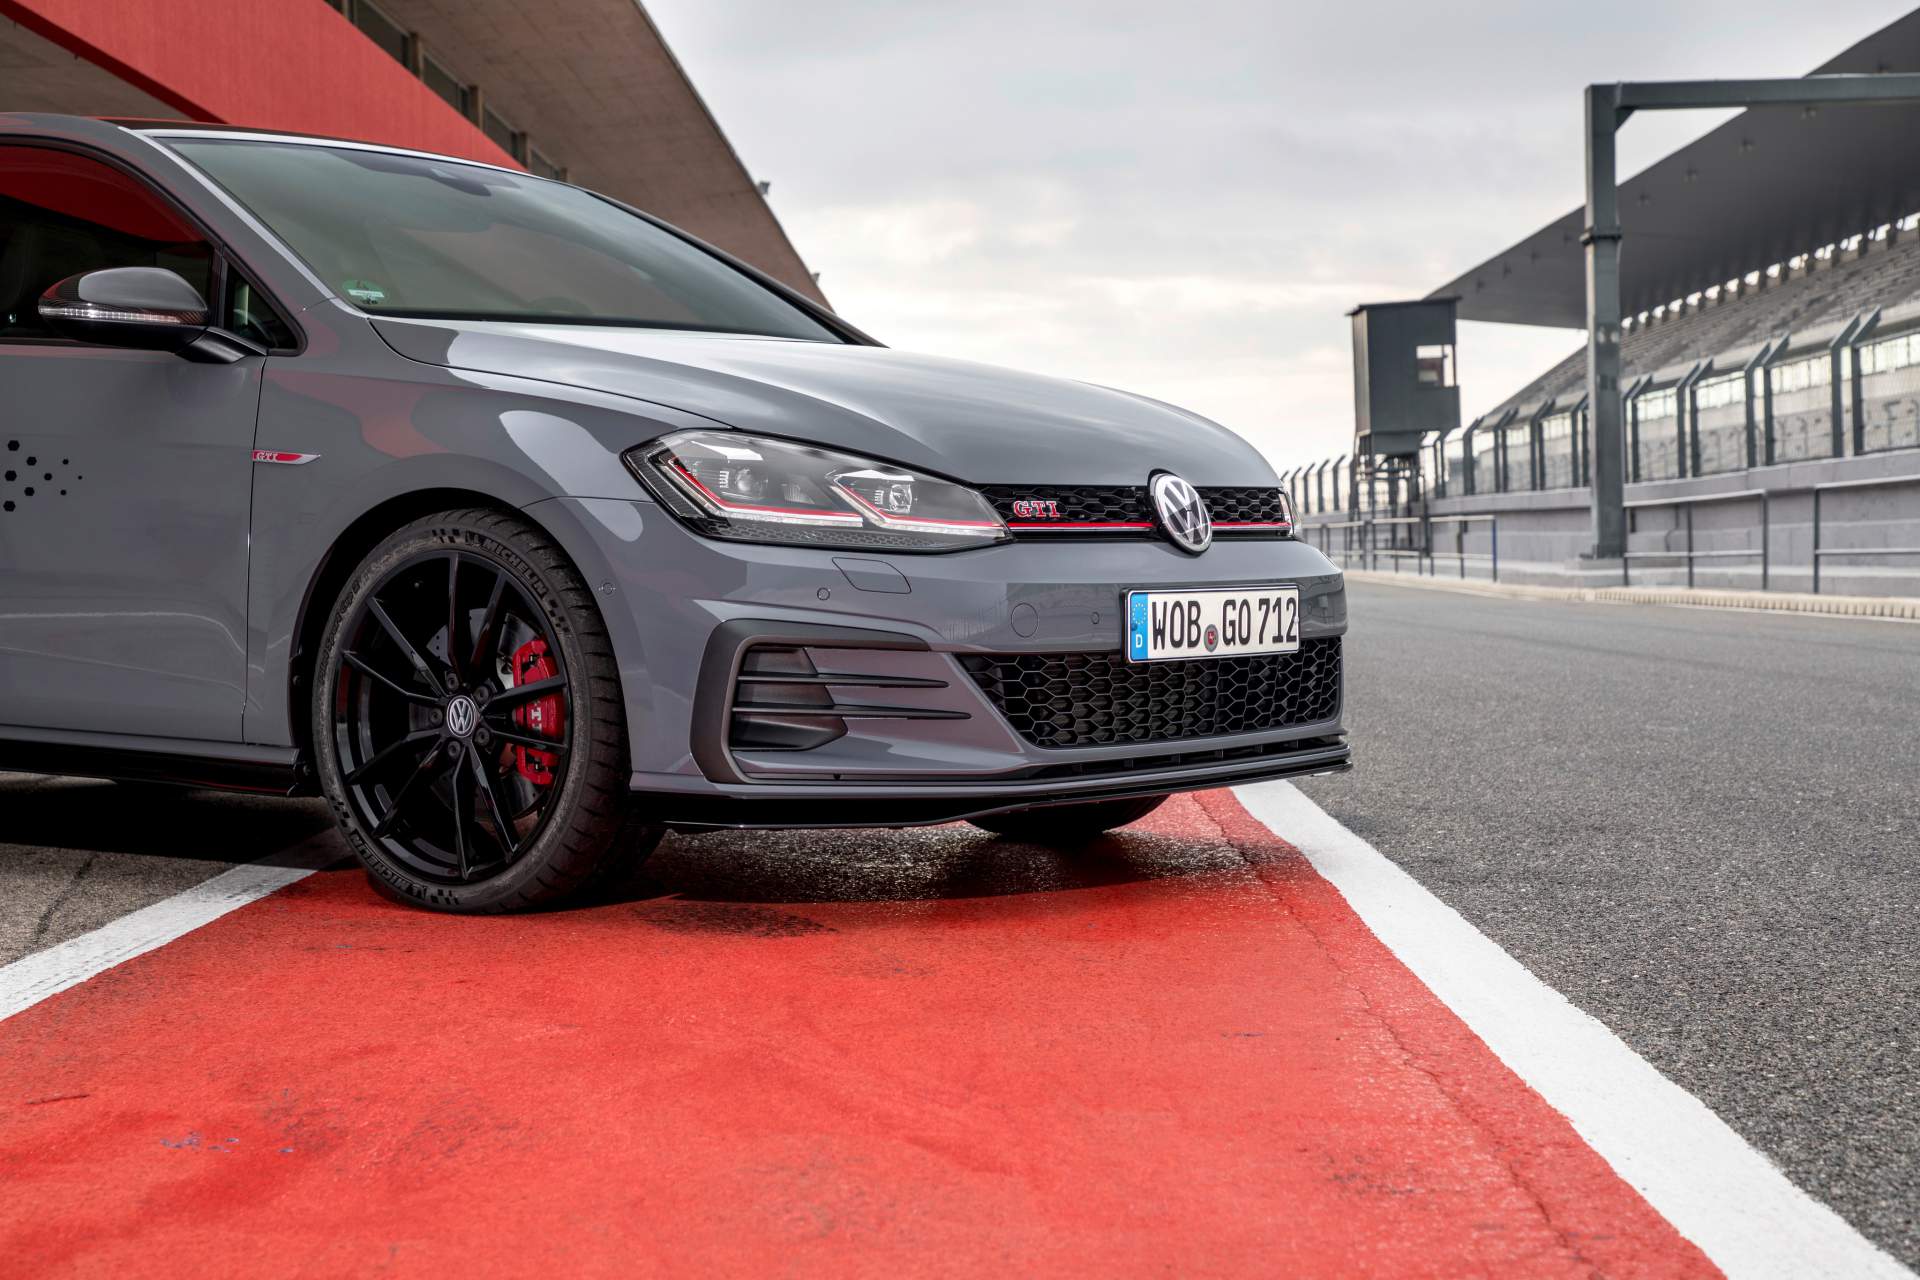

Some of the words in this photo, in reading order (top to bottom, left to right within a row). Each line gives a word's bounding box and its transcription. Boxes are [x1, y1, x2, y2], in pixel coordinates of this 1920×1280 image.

[255, 451, 278, 463] GTI
[1013, 500, 1060, 518] GTI
[481, 537, 548, 599] MICHELIN
[1135, 633, 1143, 648] D
[1152, 600, 1201, 650] WOB
[1223, 599, 1251, 646] GO
[1258, 597, 1297, 645] 712
[350, 829, 408, 892] MICHELIN
